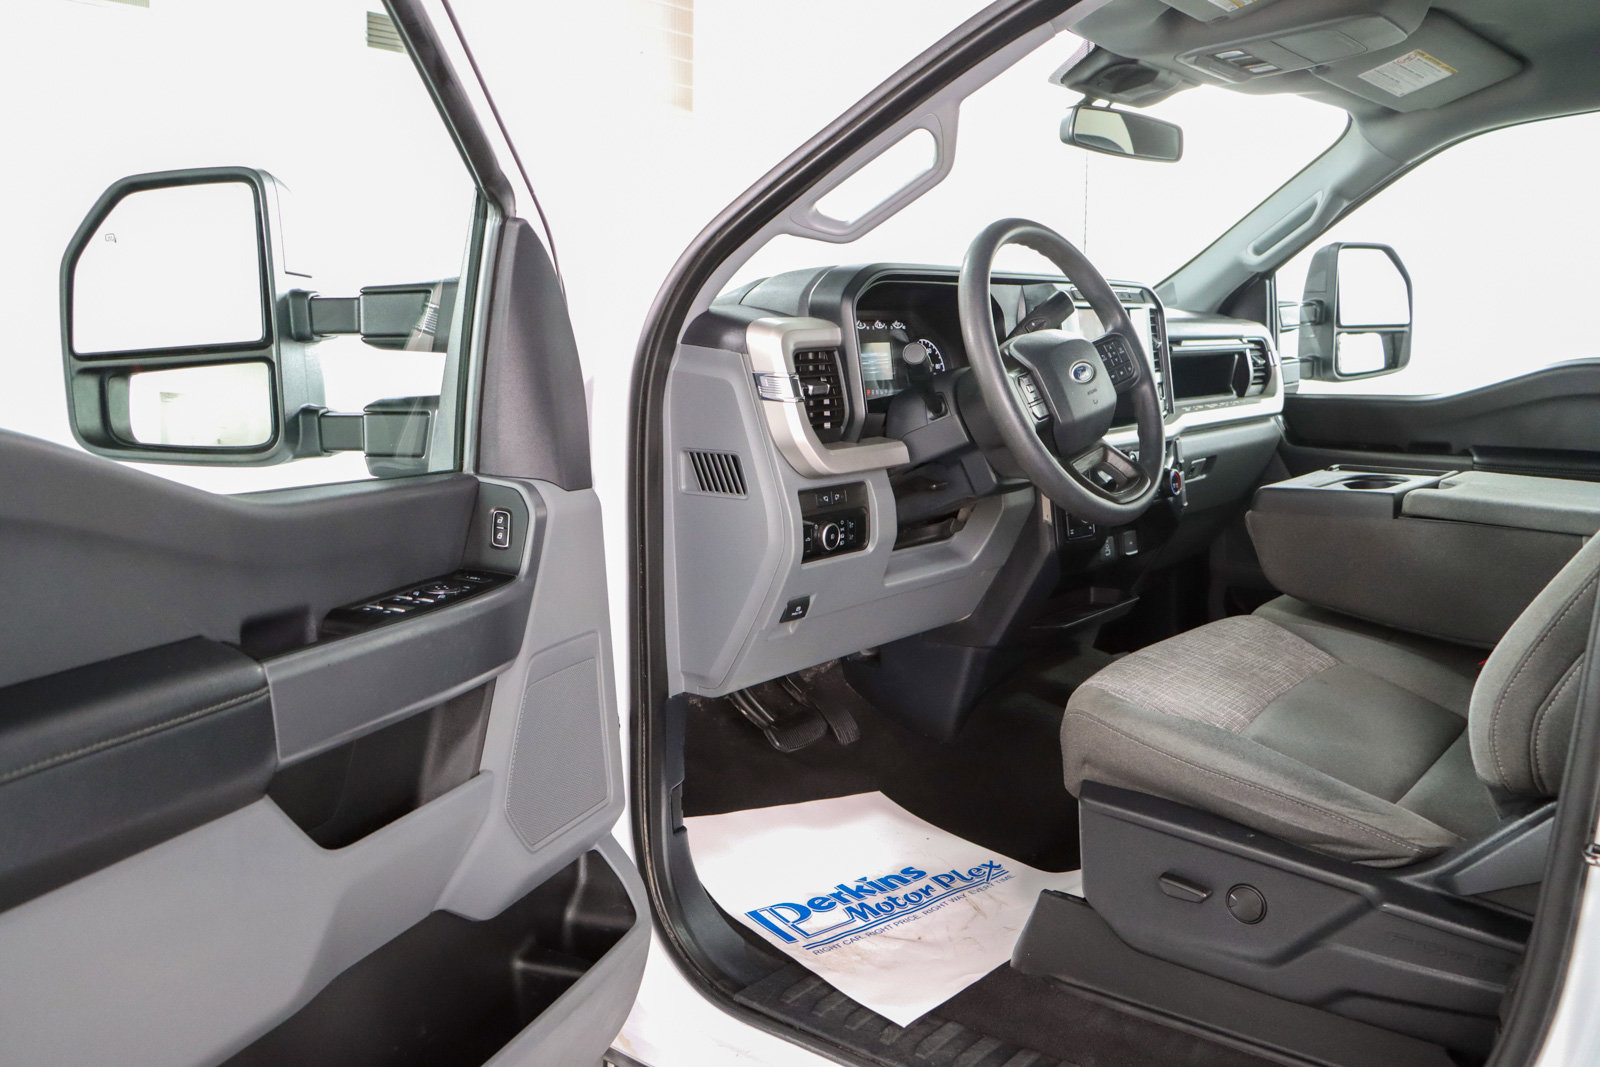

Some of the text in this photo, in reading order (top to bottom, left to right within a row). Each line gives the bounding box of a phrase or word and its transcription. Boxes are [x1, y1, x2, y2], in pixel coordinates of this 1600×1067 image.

[744, 866, 928, 944] Perkins
[812, 943, 841, 955] RIGHT
[865, 924, 893, 937] RIGHT
[922, 902, 949, 915] RIGHT
[842, 884, 937, 923] Motor
